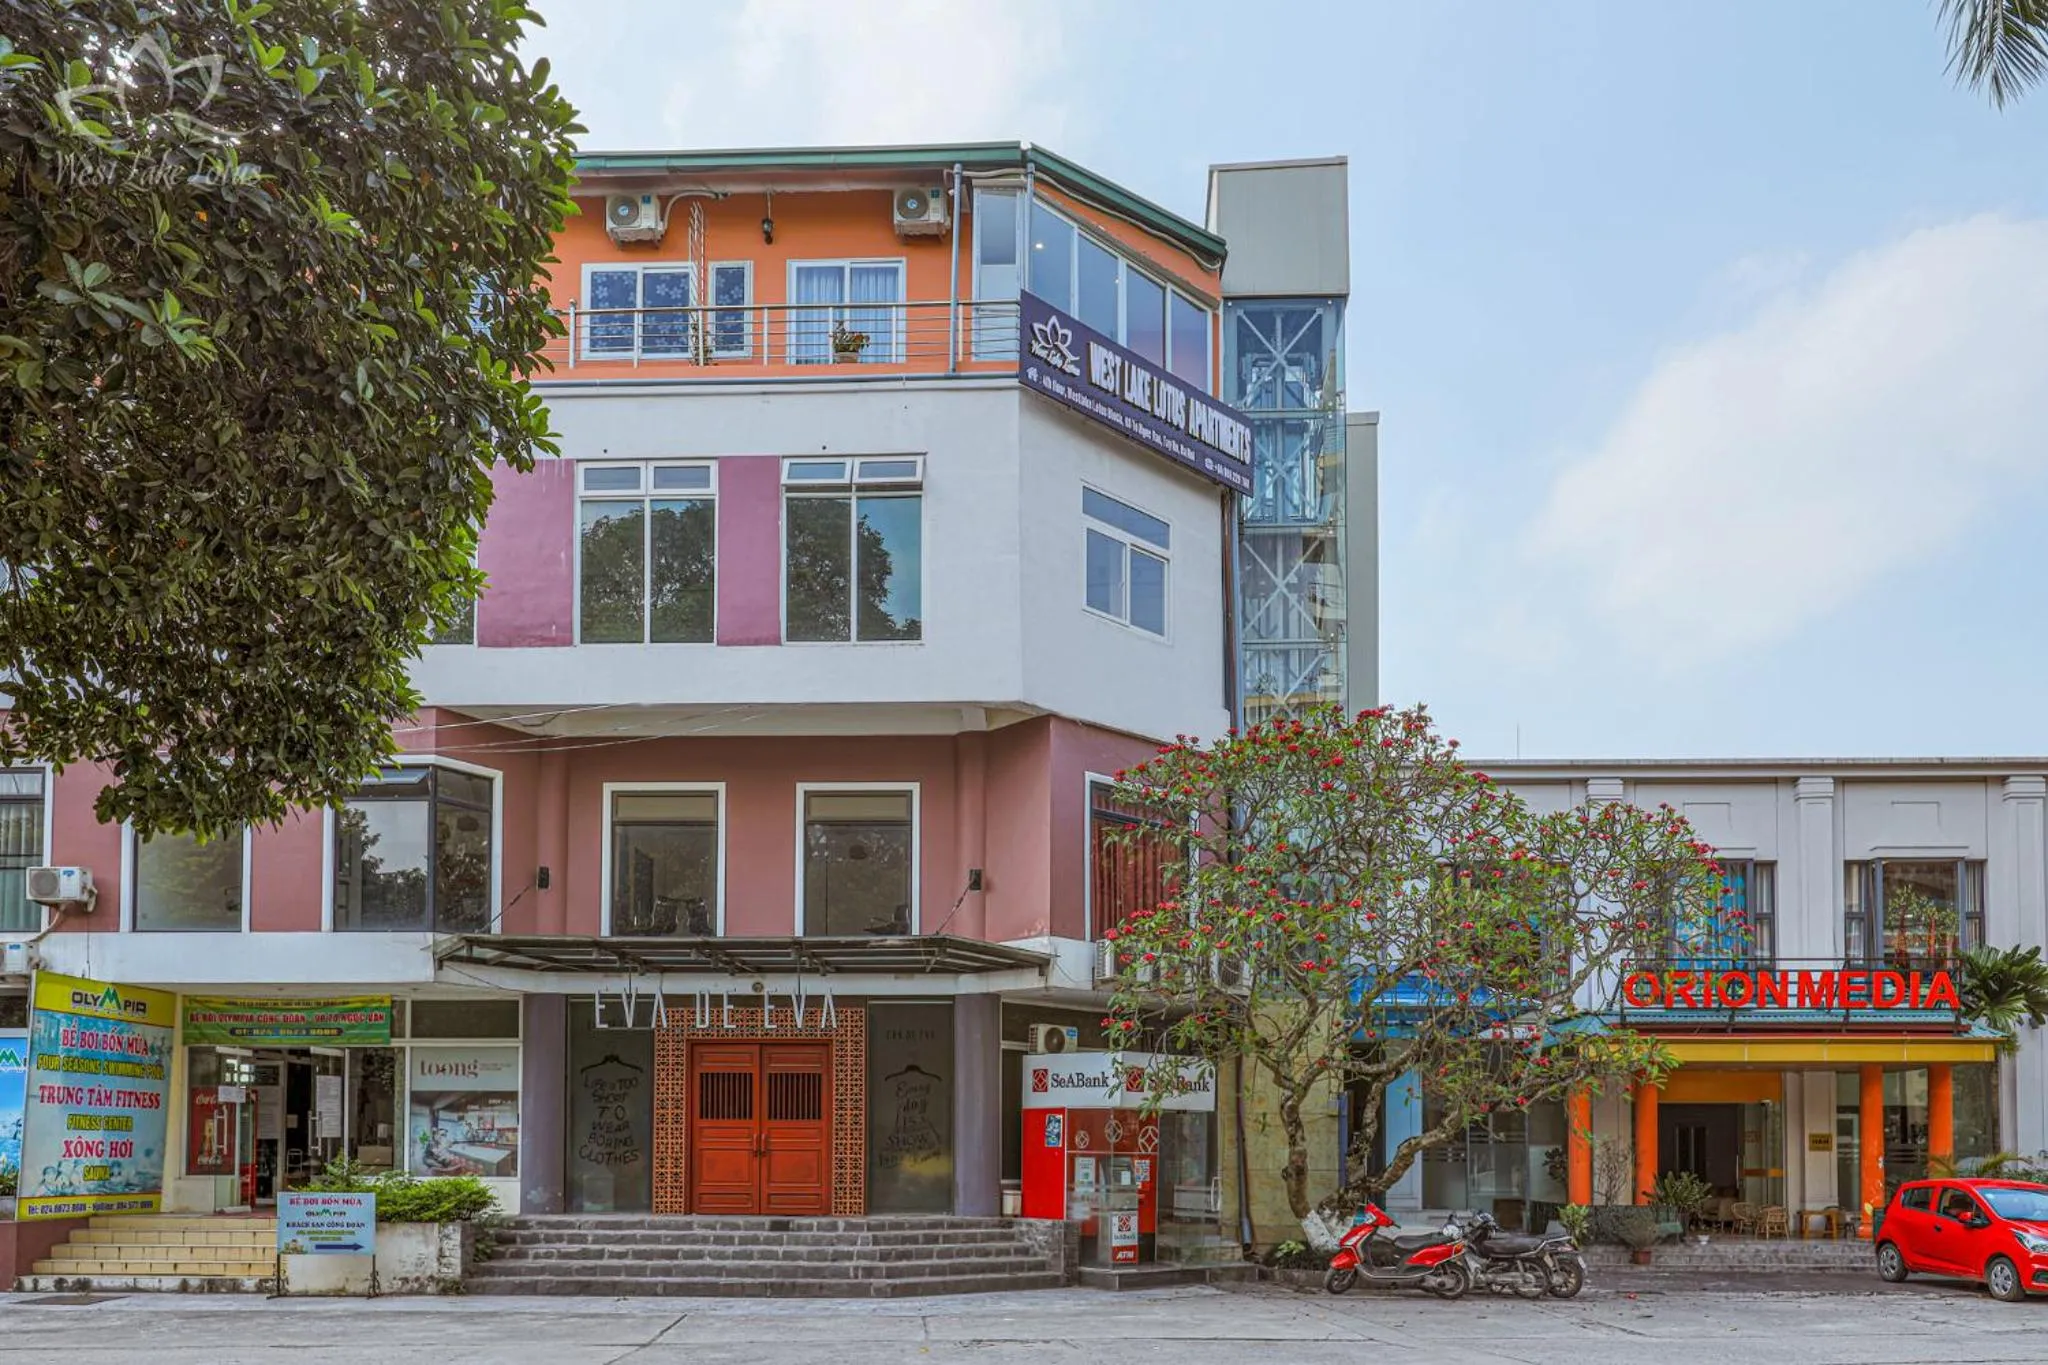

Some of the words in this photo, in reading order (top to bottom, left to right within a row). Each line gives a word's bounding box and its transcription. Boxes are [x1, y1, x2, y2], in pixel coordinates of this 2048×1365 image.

[1090, 341, 1121, 397] WEST
[1124, 359, 1151, 413] LAKE
[1153, 376, 1186, 430] LOTUS
[1189, 397, 1251, 466] APARTMENTS
[595, 988, 667, 1029] EVA
[695, 989, 737, 1029] DE
[764, 988, 837, 1029] EVA
[61, 1019, 77, 1048] BỂ
[102, 1027, 125, 1053] BỐN
[127, 1034, 149, 1056] MÙA
[37, 1054, 60, 1070] FOUR
[62, 1056, 101, 1074] SEASONS
[1050, 1071, 1110, 1090] SeABank
[39, 1085, 83, 1105] TRUNG
[87, 1083, 113, 1106] TÂM
[115, 1090, 161, 1109] FITNESS
[62, 1136, 105, 1158] XÔNG
[108, 1138, 134, 1158] HƠI
[578, 1144, 640, 1166] CLOTHES
